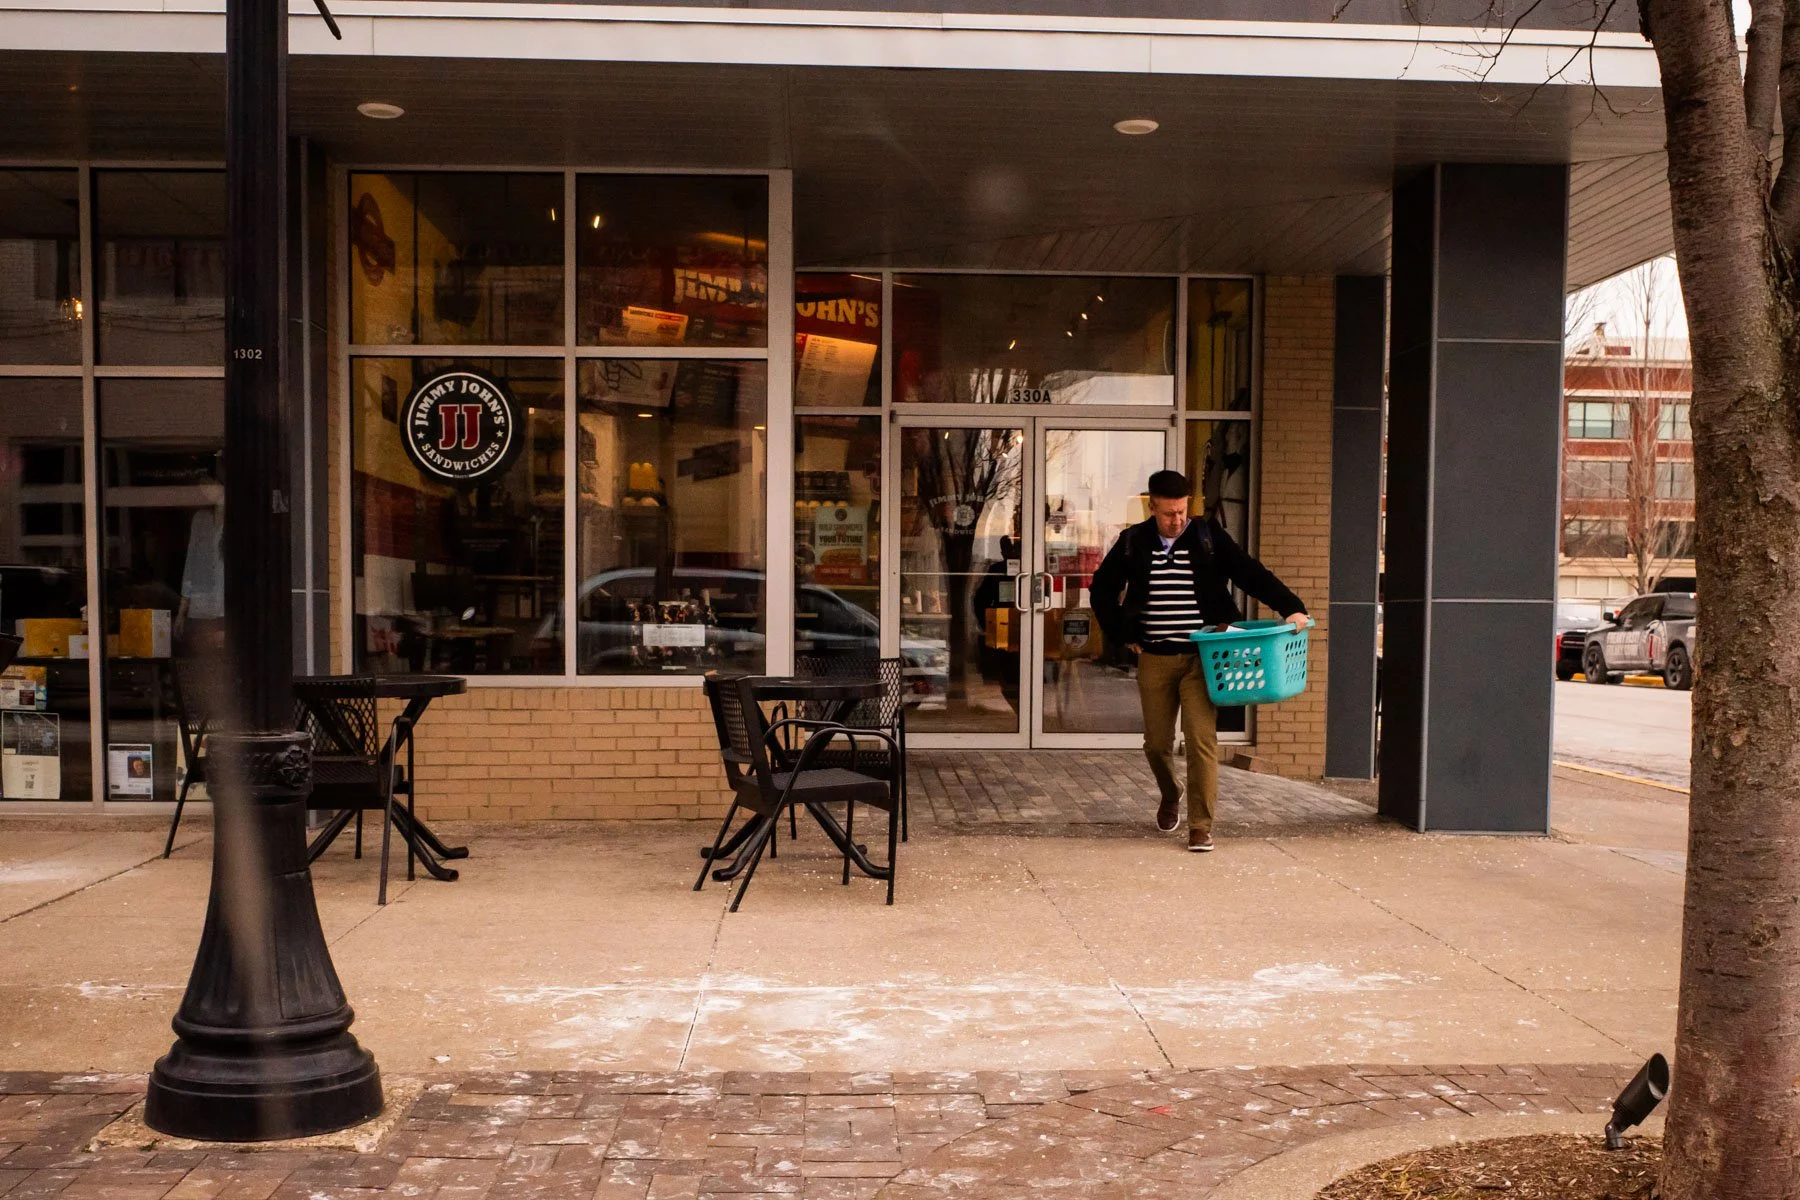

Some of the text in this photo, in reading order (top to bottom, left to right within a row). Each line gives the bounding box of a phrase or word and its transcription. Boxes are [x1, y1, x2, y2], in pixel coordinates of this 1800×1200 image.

[796, 298, 879, 328] OHN'S
[233, 348, 263, 360] 1302
[415, 380, 506, 426] JIMMY JOHN'S
[1013, 389, 1052, 403] 330A
[439, 404, 482, 450] JJ
[421, 442, 500, 471] SANDWICHES
